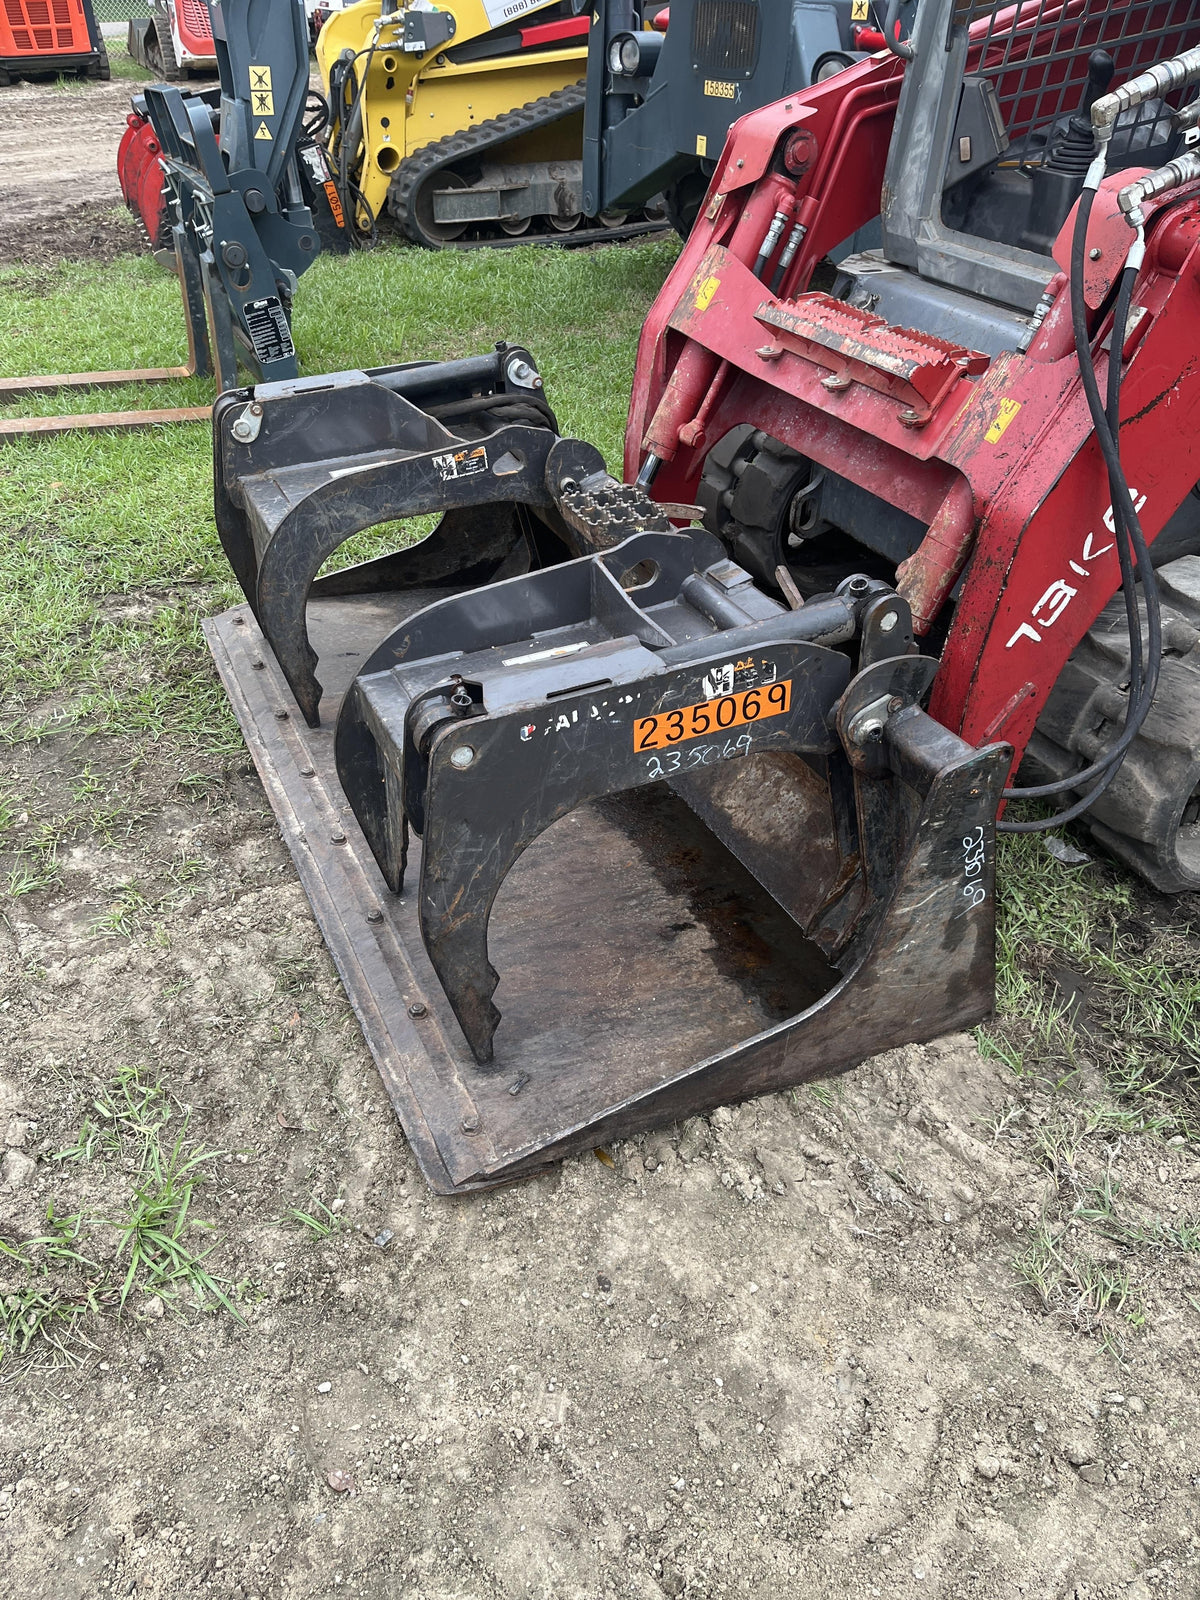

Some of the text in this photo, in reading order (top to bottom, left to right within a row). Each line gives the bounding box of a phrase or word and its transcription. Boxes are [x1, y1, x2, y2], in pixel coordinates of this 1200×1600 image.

[705, 81, 734, 98] 158355
[324, 182, 346, 226] 115017
[638, 683, 788, 751] 235069
[646, 734, 753, 779] 235069
